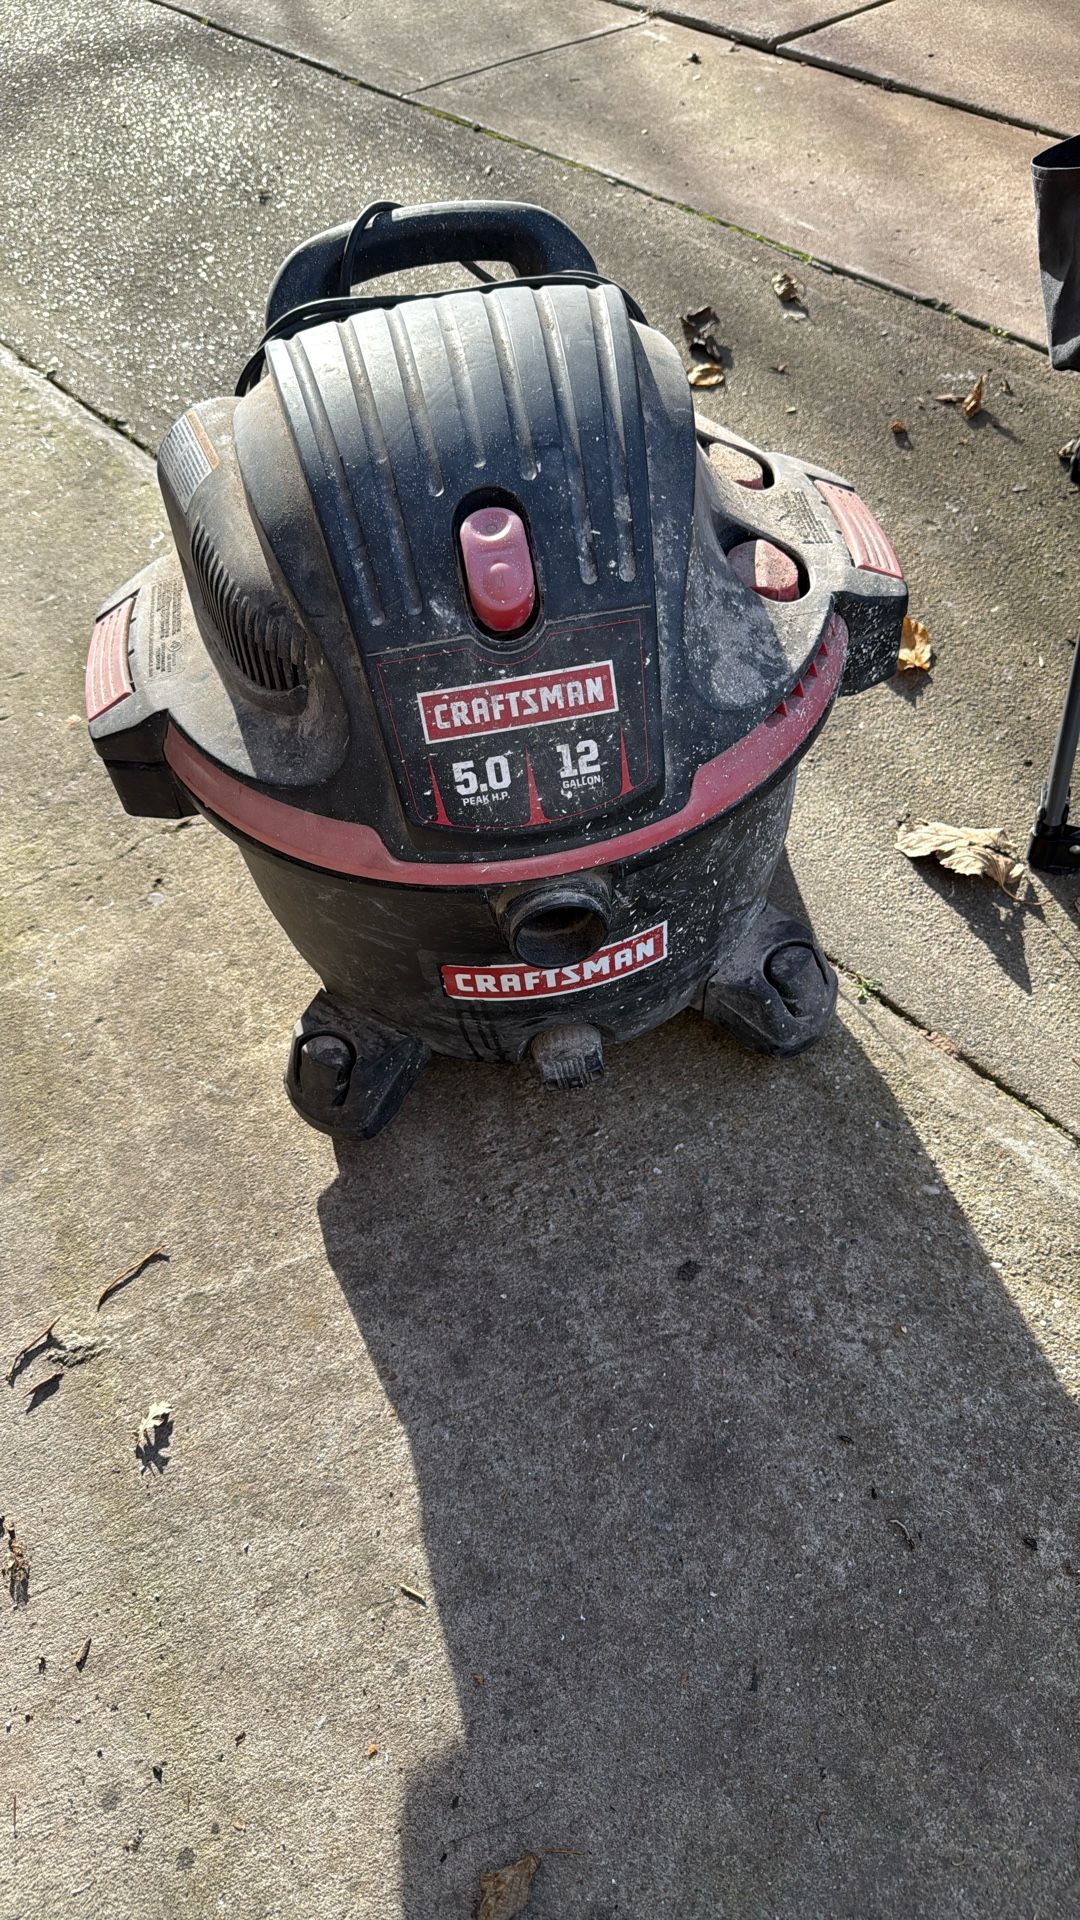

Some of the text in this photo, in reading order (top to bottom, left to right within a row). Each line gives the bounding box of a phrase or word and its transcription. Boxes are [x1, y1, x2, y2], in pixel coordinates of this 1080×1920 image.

[433, 675, 605, 730] CRAFTSMAN
[452, 754, 511, 796] 5.0
[556, 739, 602, 778] 12
[462, 791, 511, 807] PEAK H.P.
[562, 774, 602, 789] GALLON
[454, 937, 655, 993] CRAFTSMAN
